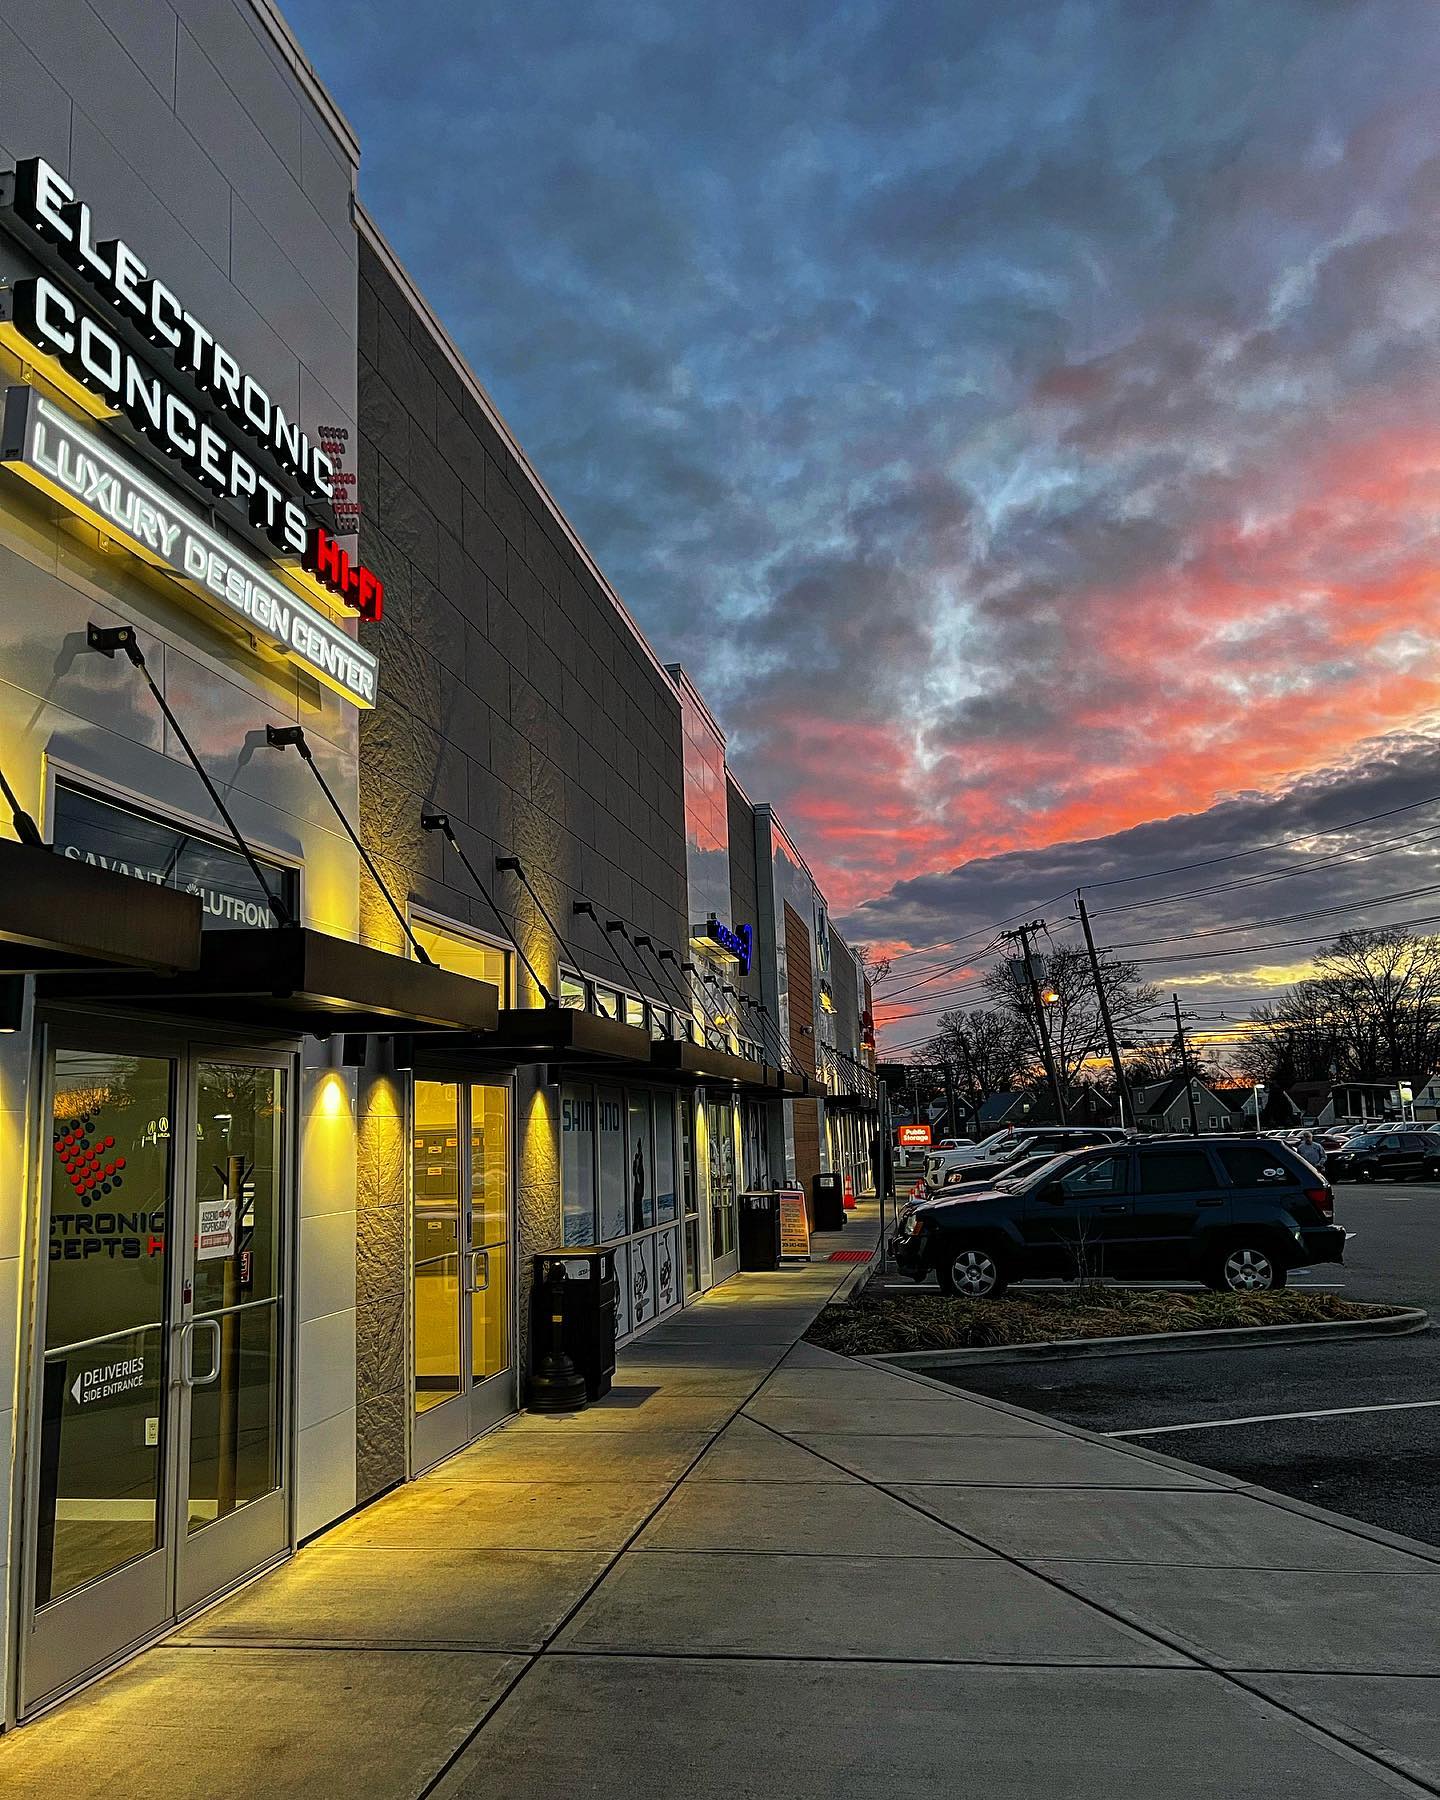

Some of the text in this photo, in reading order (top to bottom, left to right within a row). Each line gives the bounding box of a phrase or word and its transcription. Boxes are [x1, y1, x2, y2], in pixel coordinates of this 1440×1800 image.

[36, 157, 335, 500] ELECTRONIC
[36, 276, 384, 623] CONCEPTS HI-FI
[32, 422, 374, 701] LUXURY DESIGN CENTER
[200, 888, 269, 929] LUTRON
[50, 1211, 165, 1236] TRONIC
[83, 1374, 144, 1403] SIDE ENTRANCE
[84, 1356, 144, 1387] DELIVERIES
